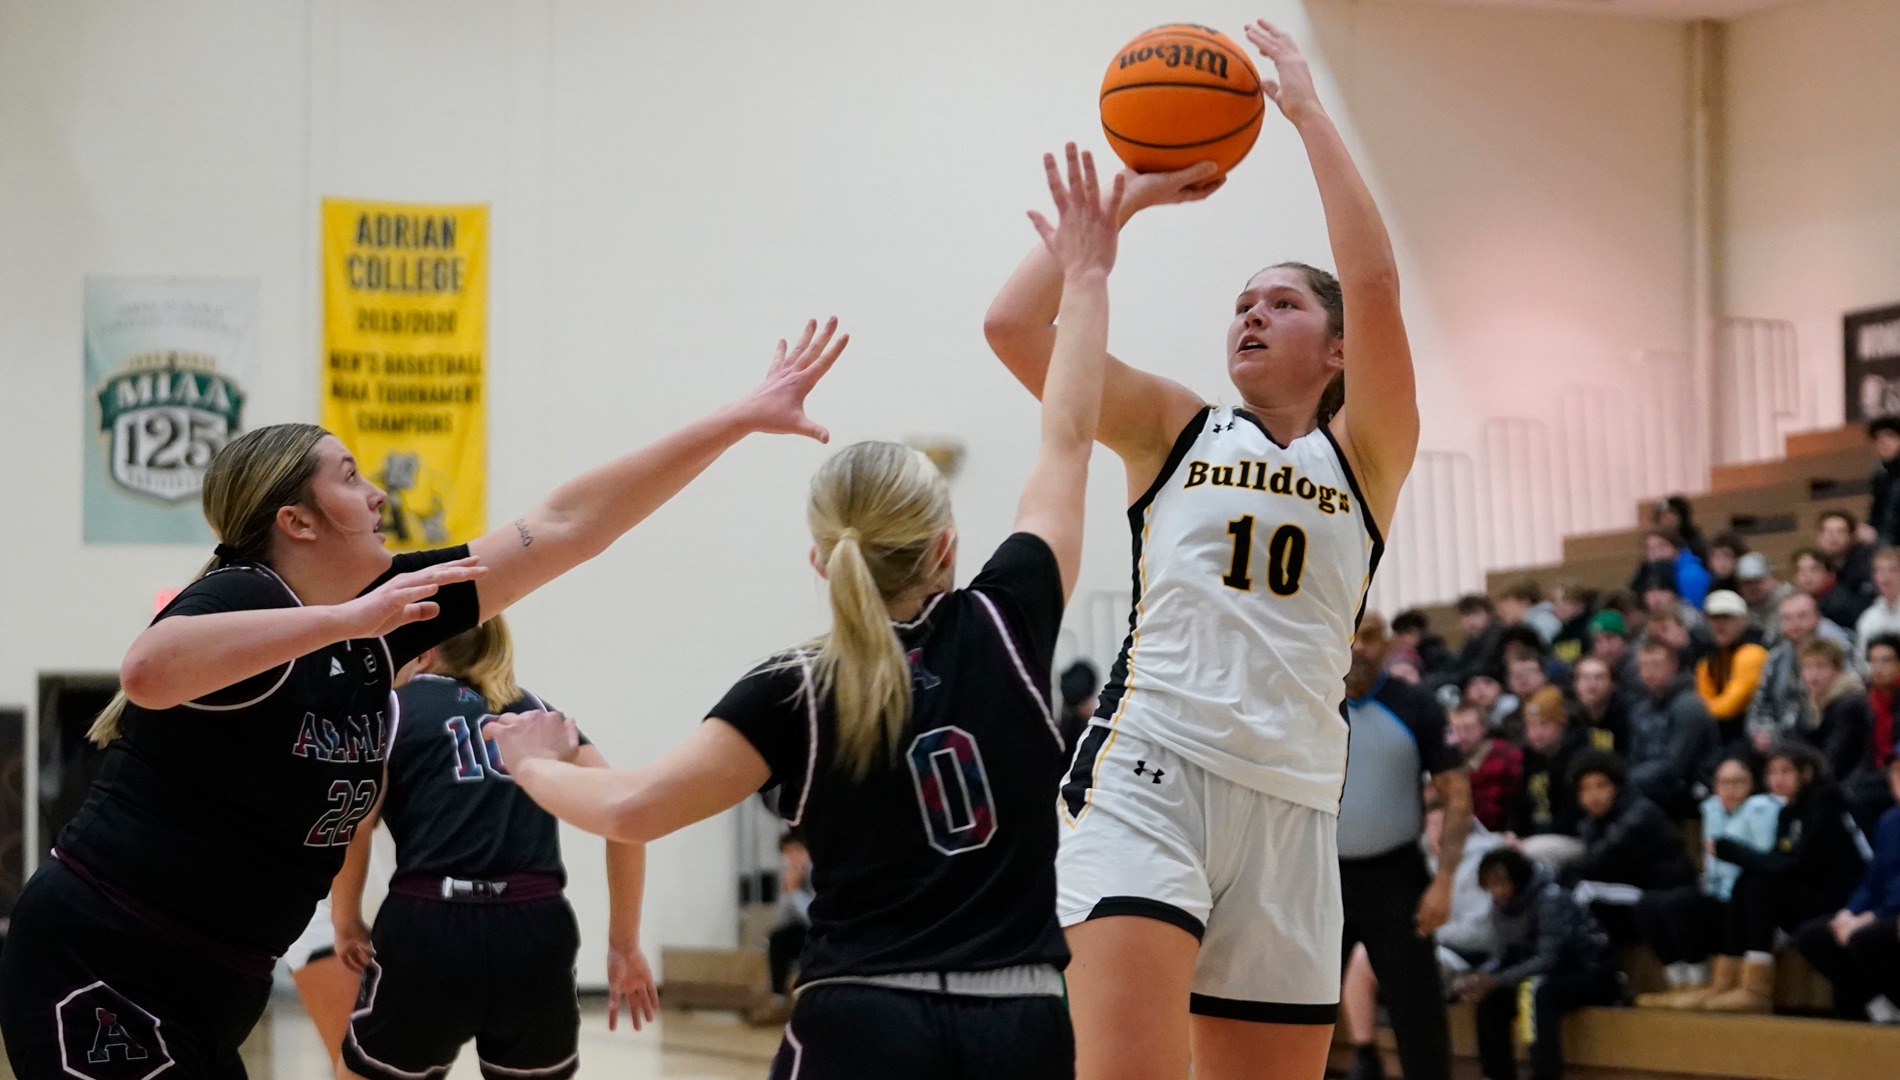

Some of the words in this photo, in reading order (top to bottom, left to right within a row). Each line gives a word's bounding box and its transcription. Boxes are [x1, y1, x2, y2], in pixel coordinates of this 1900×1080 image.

[1119, 44, 1228, 80] Wilson
[356, 212, 457, 248] ADRIAN
[347, 253, 465, 292] COLLEGE
[384, 353, 482, 377] BASKETBALL
[116, 371, 231, 412] MIAA
[376, 383, 482, 405] TOURNAMENT
[357, 410, 454, 434] CHAMPIONS
[125, 415, 219, 470] 125
[1183, 459, 1350, 515] Bulldogs
[1221, 513, 1308, 597] 10
[906, 725, 998, 856] 0
[303, 779, 377, 847] 22
